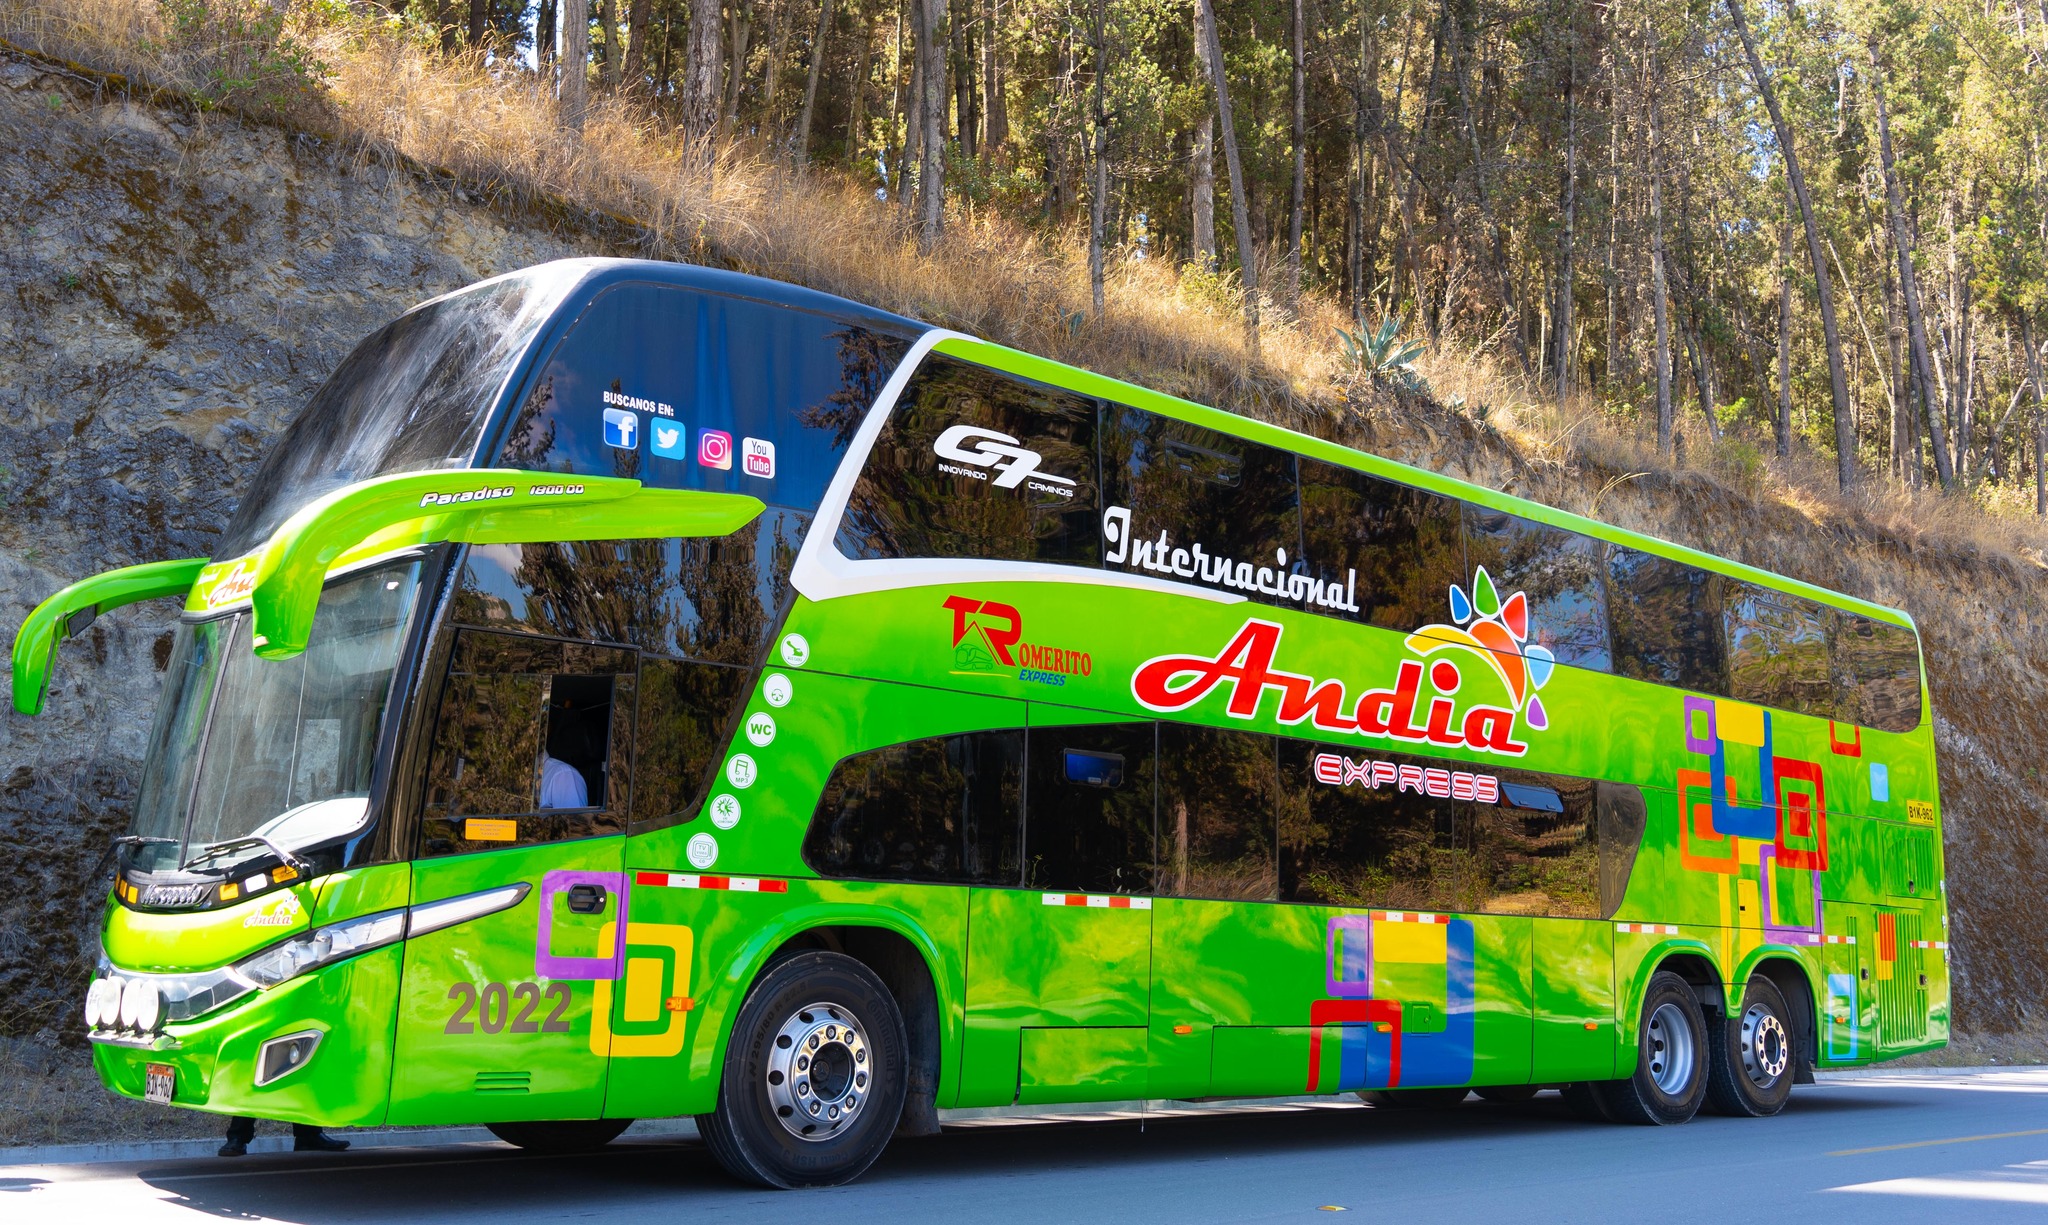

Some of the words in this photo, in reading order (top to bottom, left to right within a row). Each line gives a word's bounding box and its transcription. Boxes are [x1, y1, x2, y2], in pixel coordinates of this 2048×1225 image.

[603, 391, 656, 412] BUSCANOS
[658, 403, 675, 417] EN:
[752, 440, 767, 455] You
[749, 456, 769, 473] Tube
[938, 463, 987, 481] INNOVANDO
[419, 486, 515, 508] Paradiso
[529, 484, 565, 496] 1800
[1028, 481, 1074, 498] CAMINOS
[1103, 505, 1360, 613] Internacional
[1019, 669, 1067, 687] EXPRESS
[1131, 617, 1529, 758] Andia
[751, 723, 772, 736] WC
[1314, 753, 1499, 804] EXPRESS
[1909, 806, 1934, 821] B1K-962
[444, 982, 572, 1034] 2022
[146, 1073, 172, 1098] B1K-962
